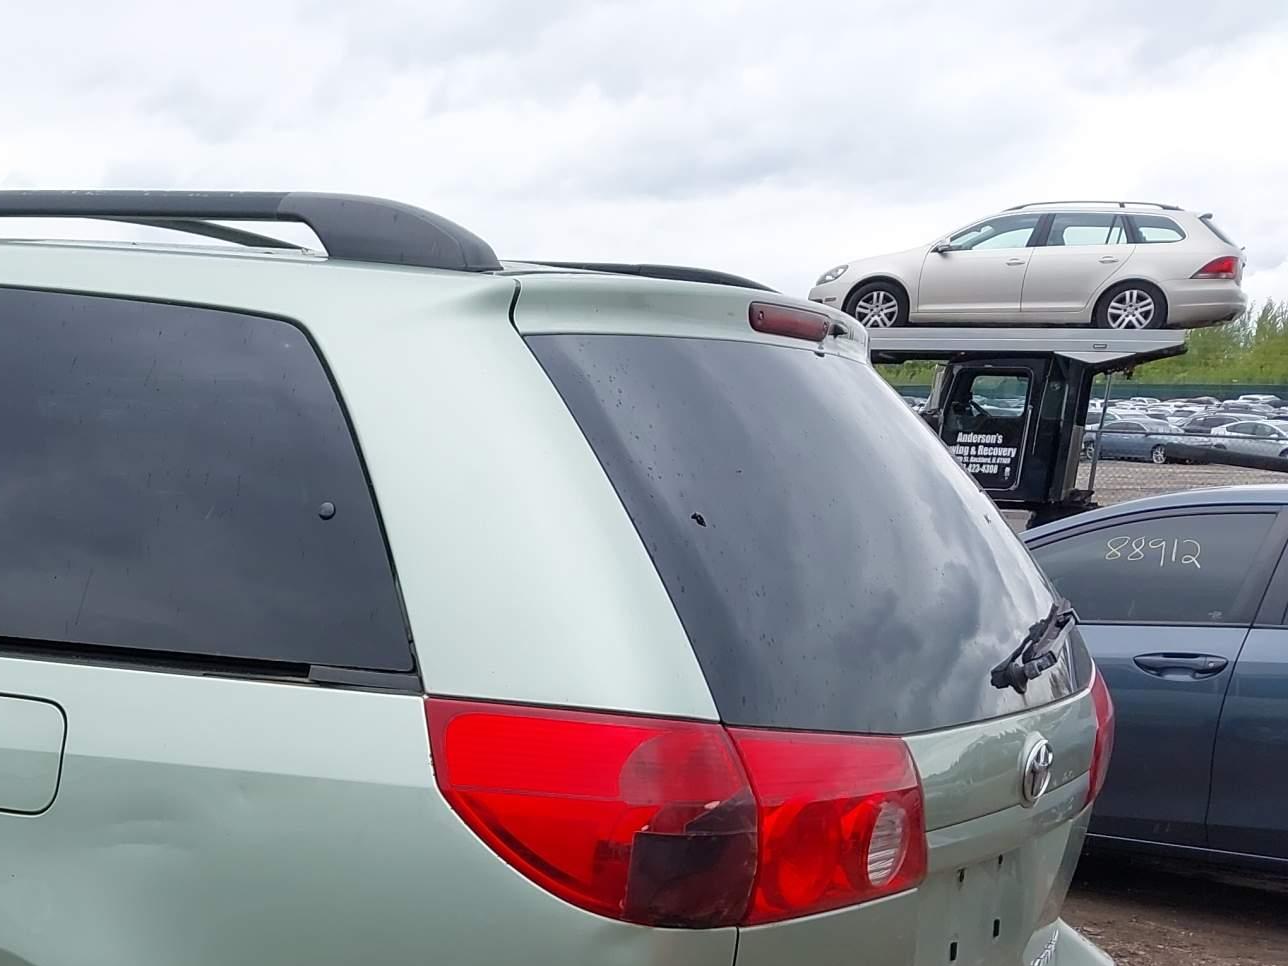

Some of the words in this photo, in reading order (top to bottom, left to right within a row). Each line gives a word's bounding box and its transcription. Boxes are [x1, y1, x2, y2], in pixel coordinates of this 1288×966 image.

[957, 432, 1003, 443] Anderson's
[948, 445, 969, 455] wing
[970, 447, 976, 455] &
[977, 445, 1017, 458] Recovery
[1105, 536, 1201, 568] 88912
